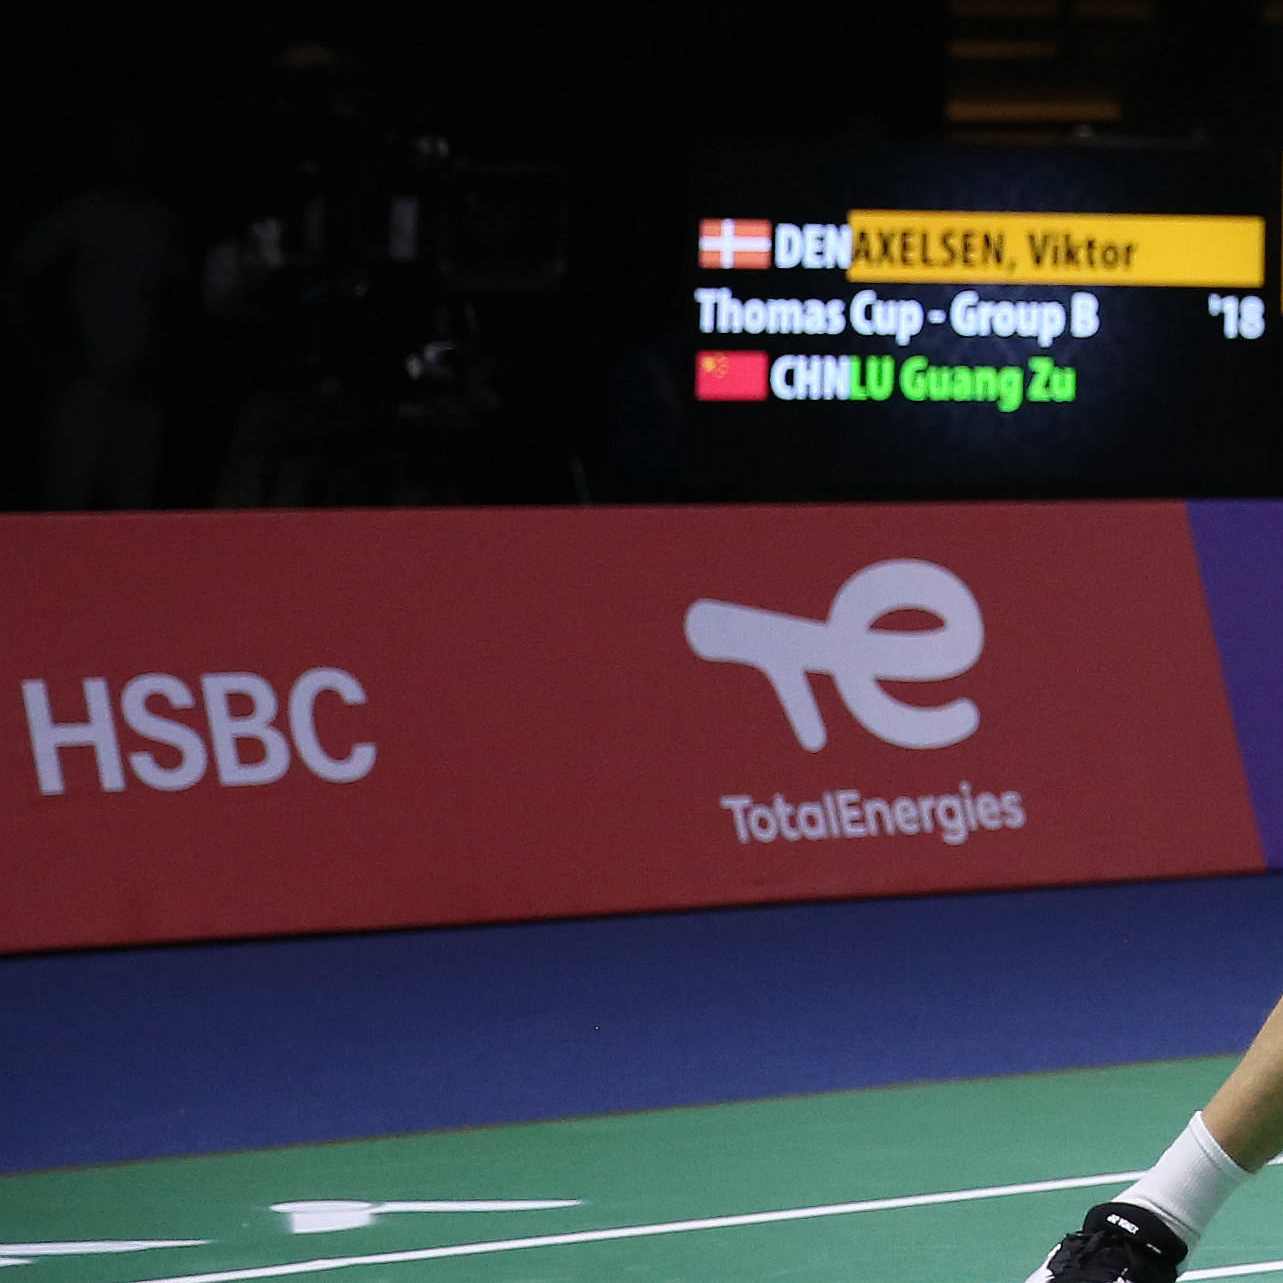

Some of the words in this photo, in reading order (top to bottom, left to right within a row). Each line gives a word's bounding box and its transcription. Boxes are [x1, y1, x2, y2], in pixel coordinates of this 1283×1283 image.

[775, 222, 851, 269] DEN
[852, 229, 1017, 273] AXELSEN,
[1027, 232, 1138, 270] Viktor
[694, 287, 847, 335] Thomas
[850, 289, 924, 346] Cup
[950, 290, 1066, 348] Group
[1070, 291, 1100, 338] B
[770, 355, 850, 401] CHN
[849, 355, 895, 401] LU
[900, 355, 1024, 413] Guang
[1027, 356, 1077, 402] Zu
[21, 667, 377, 796] HSBC
[720, 781, 1025, 845] TotalEnergies
